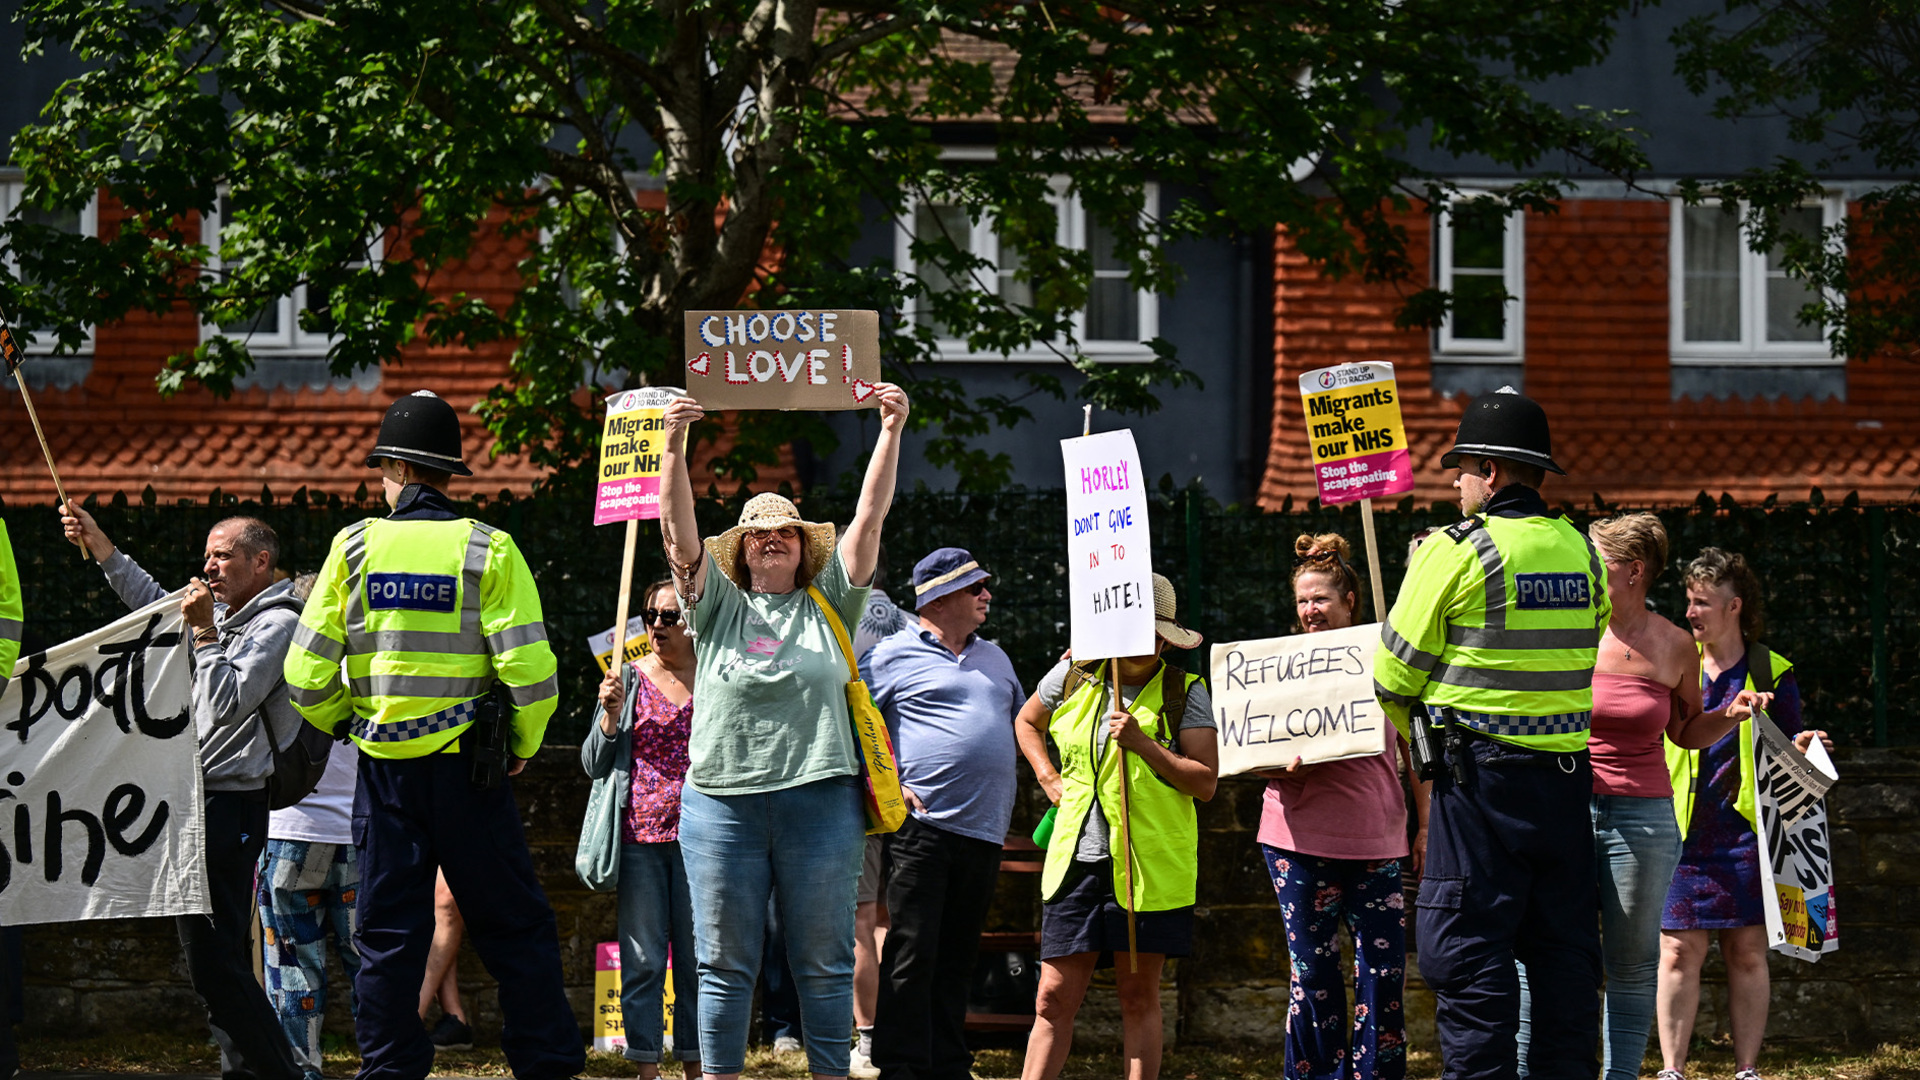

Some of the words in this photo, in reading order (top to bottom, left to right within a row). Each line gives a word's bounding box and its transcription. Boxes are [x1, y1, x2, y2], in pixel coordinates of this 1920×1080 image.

[699, 311, 838, 347] CHOOSE
[1336, 367, 1359, 377] STAND
[1360, 366, 1370, 374] UP
[1349, 373, 1375, 383] RACISM
[637, 391, 659, 399] STAND
[1308, 388, 1393, 417] Migrants
[607, 416, 665, 437] Migran
[1313, 415, 1365, 438] make
[605, 437, 650, 458] make
[1317, 440, 1348, 458] our
[1352, 428, 1393, 452] NHS
[603, 461, 630, 477] our
[633, 453, 664, 473] NH
[1081, 459, 1130, 494] HORLEY
[1321, 466, 1347, 478] Stop
[1349, 461, 1368, 473] the
[601, 485, 622, 498] Stop
[625, 482, 641, 494] the
[1323, 469, 1398, 491] scapegoating
[599, 493, 660, 509] scapegoatin
[1074, 512, 1100, 536] DON'T
[1109, 506, 1132, 533] GIVE
[1089, 550, 1099, 570] IN
[1110, 544, 1125, 561] TO
[370, 581, 451, 602] POLICE
[1093, 582, 1142, 614] HATE!
[1519, 579, 1588, 603] POLICE
[1226, 645, 1364, 691] REFUGEES
[1221, 699, 1375, 747] WELCOME
